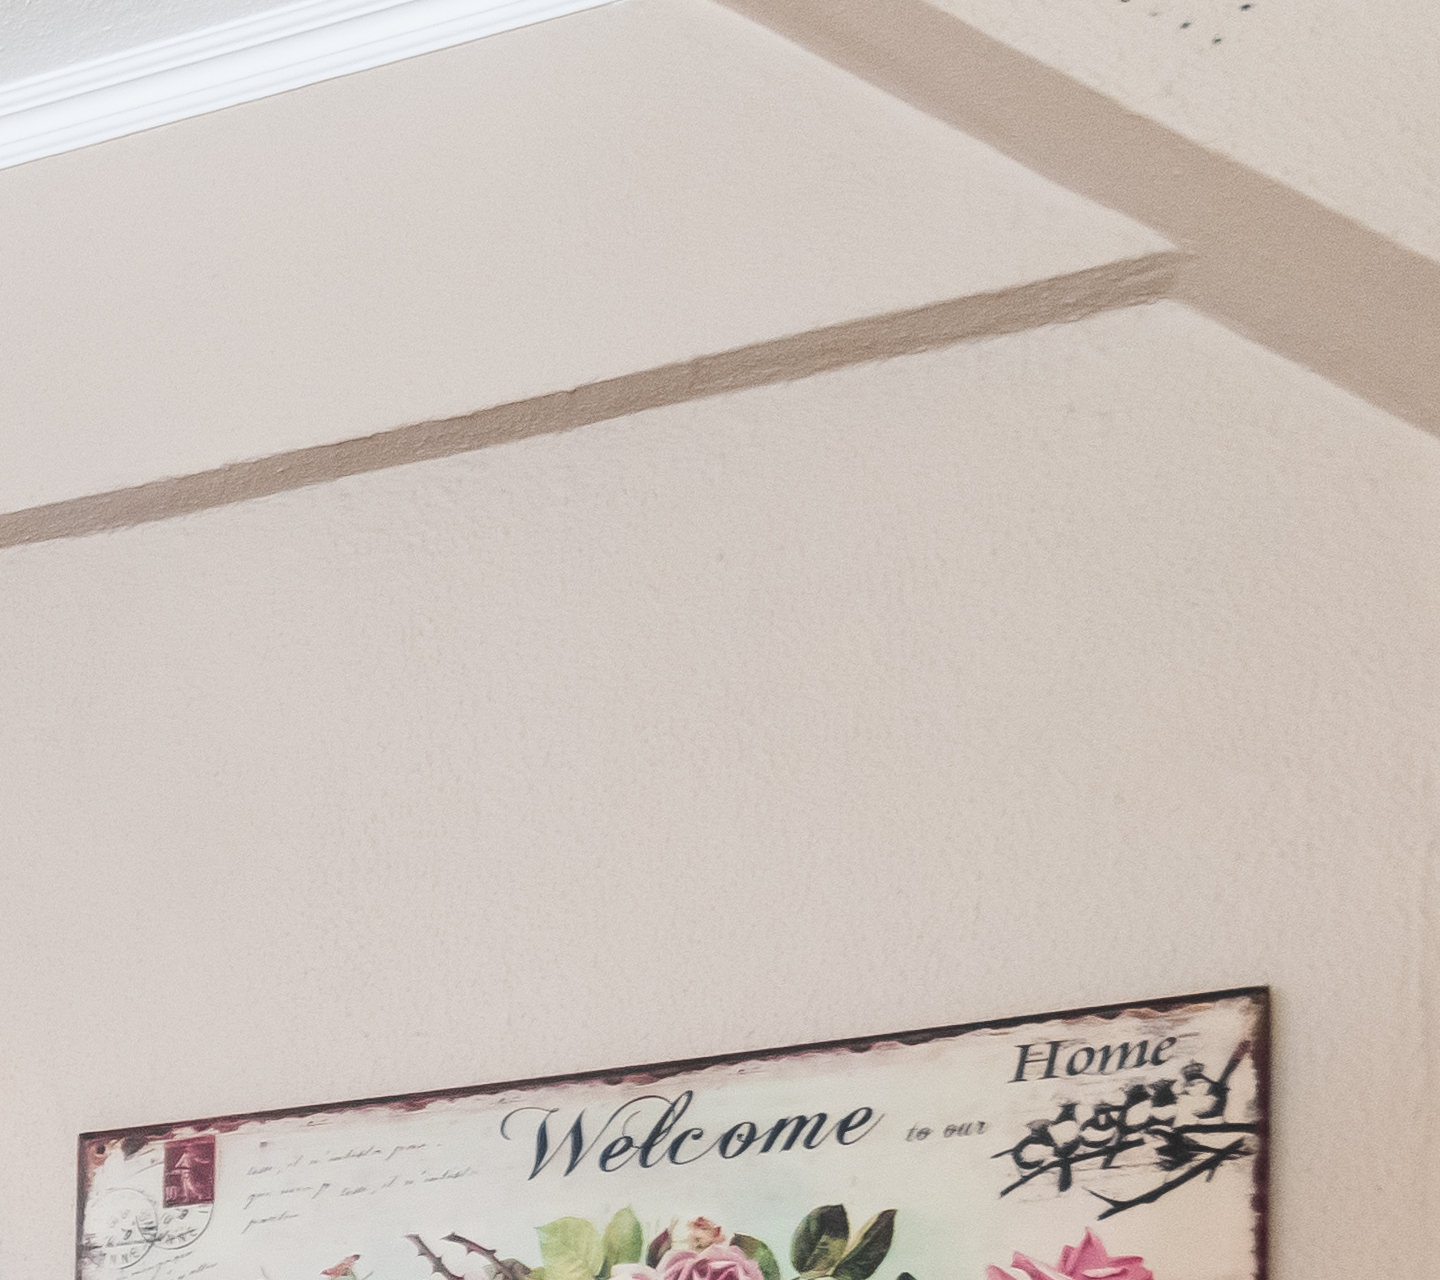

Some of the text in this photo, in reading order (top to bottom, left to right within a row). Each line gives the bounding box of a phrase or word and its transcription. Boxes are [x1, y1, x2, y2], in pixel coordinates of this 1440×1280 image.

[1009, 1035, 1177, 1083] Home
[500, 1090, 989, 1181] Welcome to our
